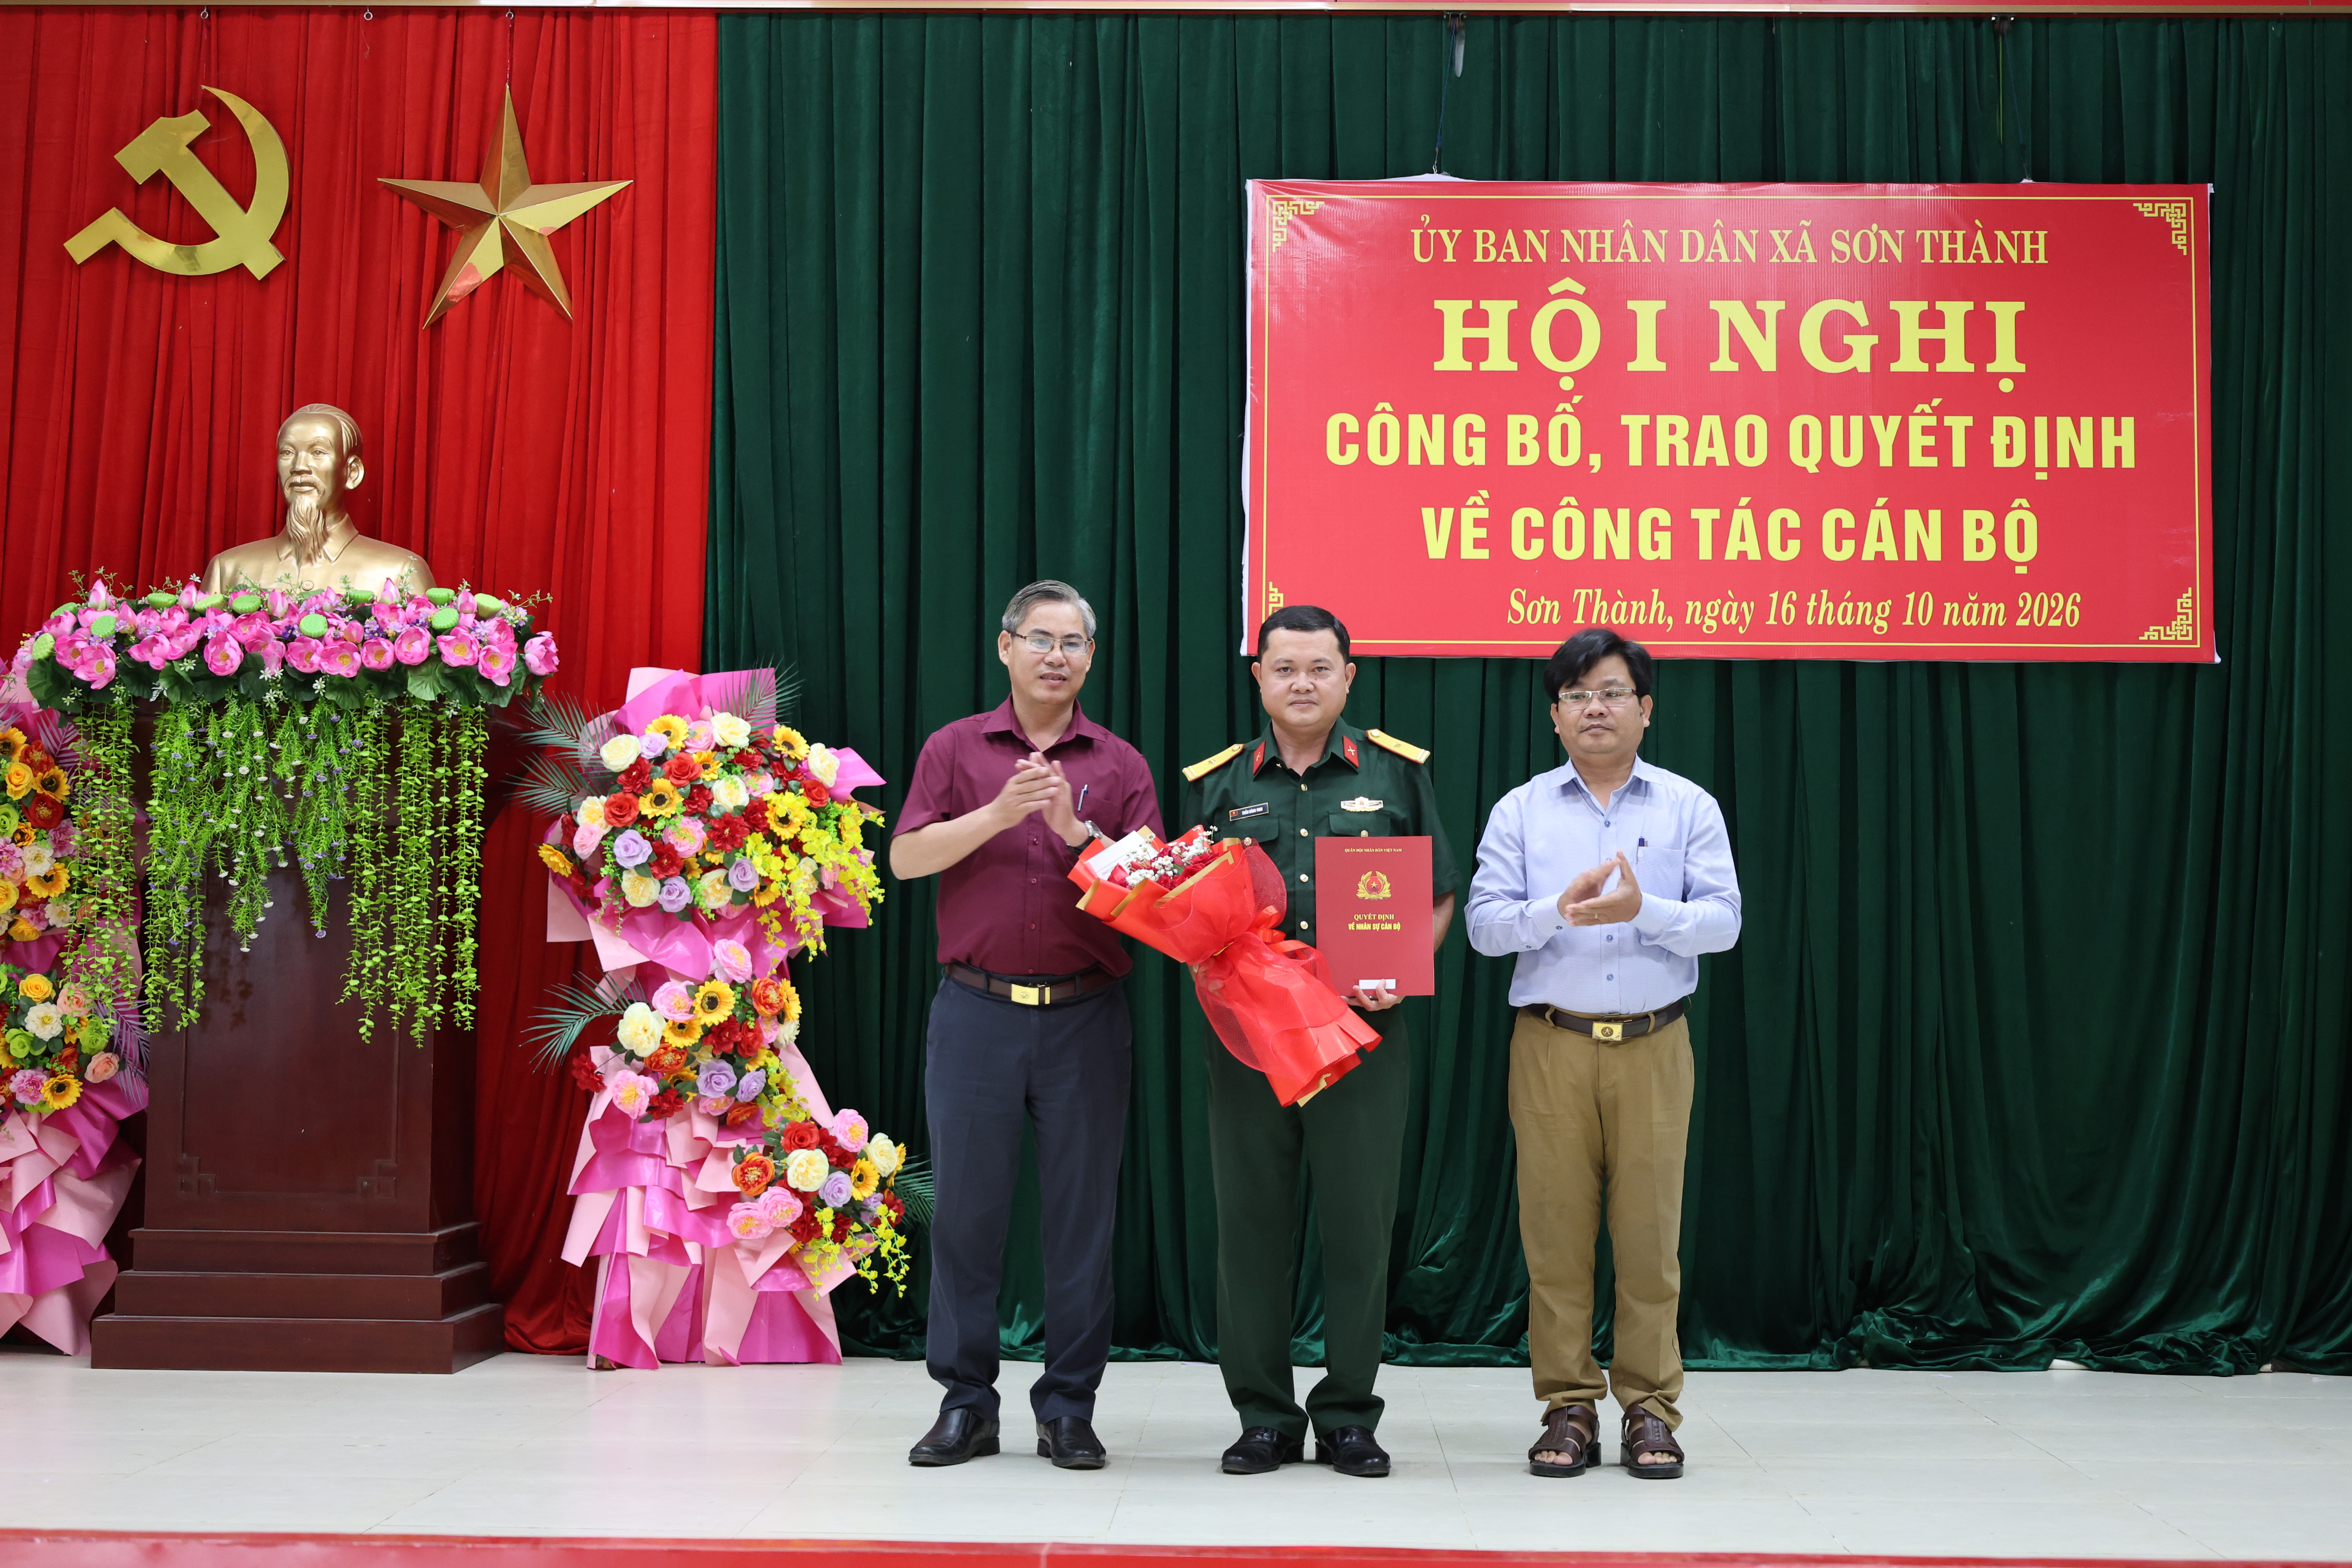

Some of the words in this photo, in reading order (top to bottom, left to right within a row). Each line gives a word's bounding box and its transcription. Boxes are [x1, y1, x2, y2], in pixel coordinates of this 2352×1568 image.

[1411, 214, 1462, 262] ỦY
[1474, 229, 1550, 262] BAN
[1561, 220, 1668, 262] NHÂN
[1680, 220, 1758, 262] DÂN
[1770, 221, 1817, 262] XÃ
[1832, 224, 1905, 263] SƠN
[1916, 220, 2048, 263] THÀNH
[1434, 277, 1666, 390] HỘI
[1710, 299, 2025, 392] NGHỊ
[1327, 403, 1485, 466] CÔNG
[1507, 396, 1601, 473] BỐ,
[1621, 414, 1767, 466] TRAO
[1789, 398, 1973, 473] QUYẾT
[1991, 416, 2134, 479] ĐỊNH
[1421, 490, 1489, 559] VỀ
[1512, 497, 1671, 560] CÔNG
[1691, 497, 1800, 561] TÁC
[1822, 498, 1941, 561] CÁN
[1963, 499, 2037, 573] BỘ
[1508, 588, 1561, 624] Sơn
[1573, 589, 1673, 632] Thành,
[1686, 590, 1754, 633] ngày
[1766, 591, 1797, 625] 16
[1807, 590, 1891, 634] tháng
[1903, 592, 1933, 626] 10
[1943, 593, 2006, 626] năm
[2016, 592, 2080, 626] 2026
[1354, 913, 1377, 921] QUYẾT
[1372, 923, 1380, 931] SỰ
[1381, 922, 1392, 930] CÁN
[1393, 922, 1401, 931] BỘ
